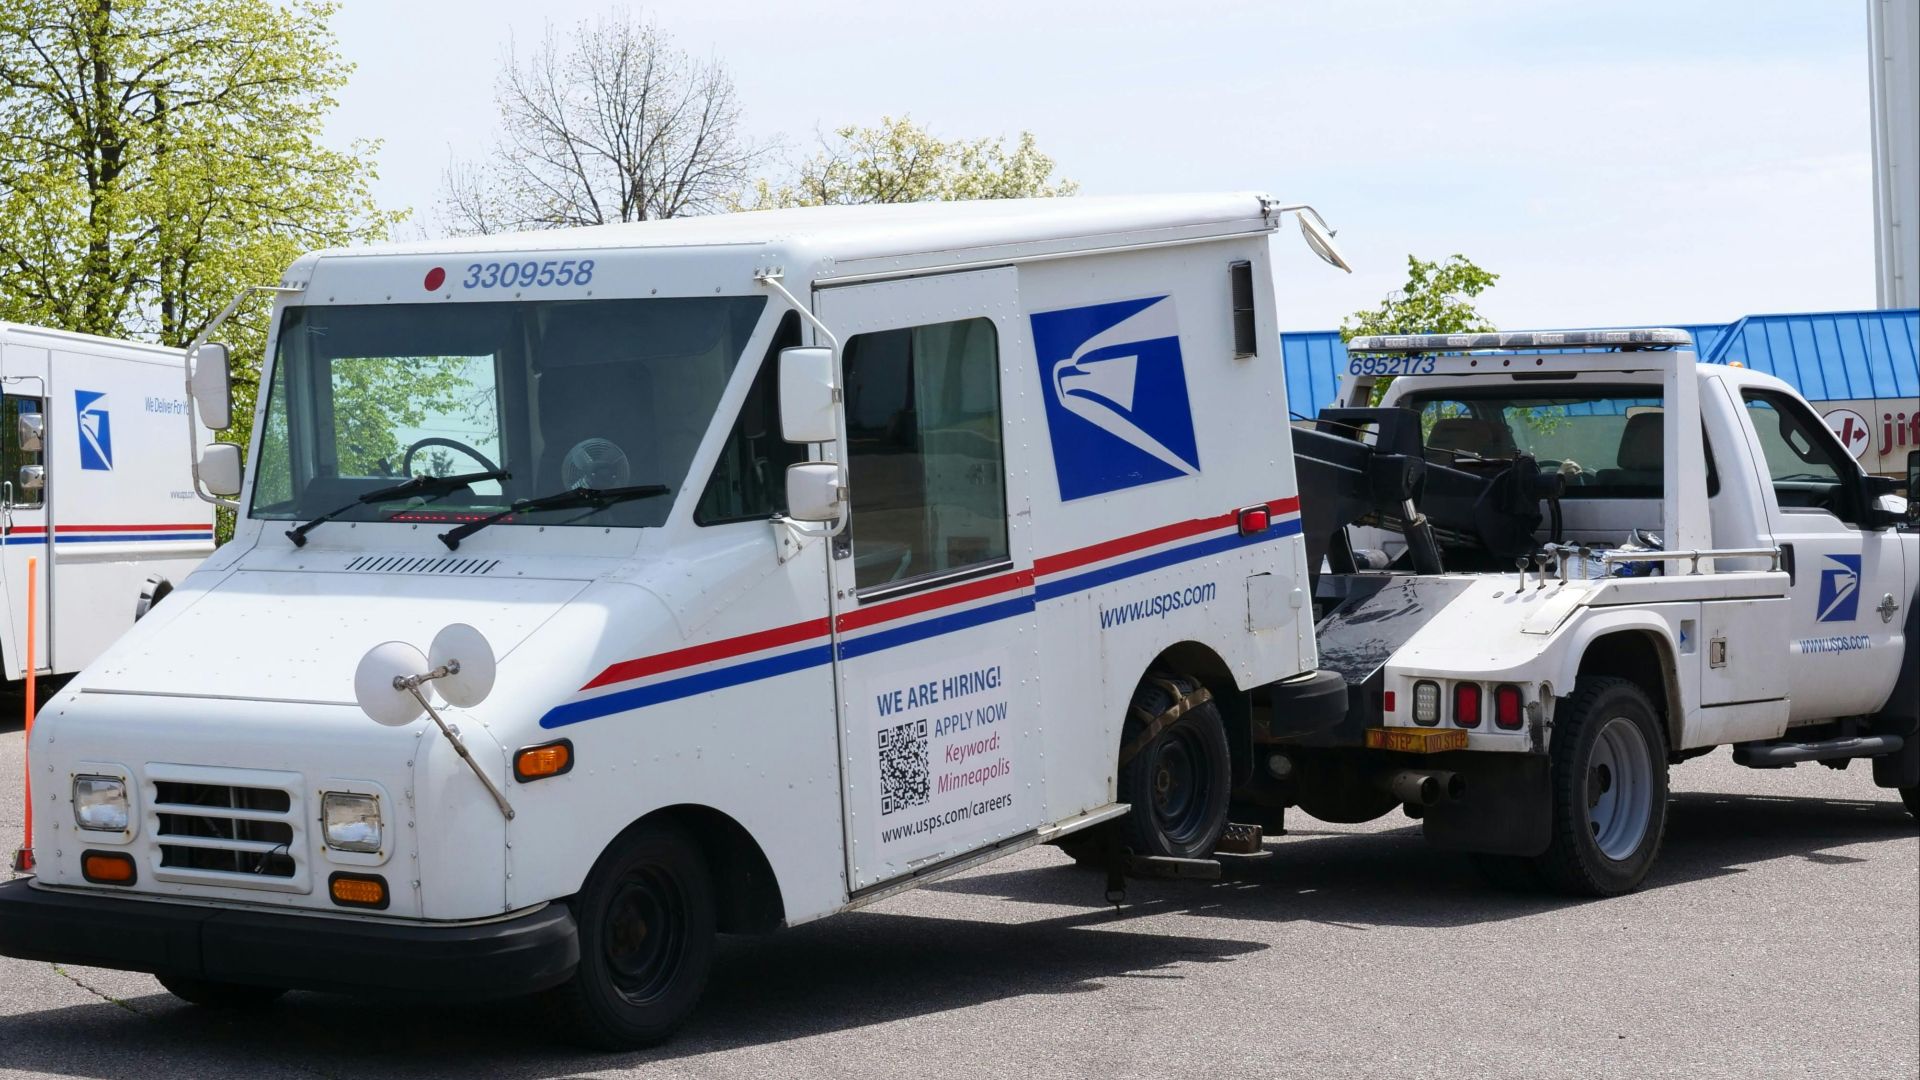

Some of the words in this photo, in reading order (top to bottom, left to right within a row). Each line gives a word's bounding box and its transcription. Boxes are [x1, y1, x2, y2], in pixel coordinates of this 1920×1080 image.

[463, 259, 594, 289] 3309558
[1349, 356, 1436, 376] 6952173
[145, 397, 154, 412] We
[154, 397, 173, 414] Deliver
[174, 399, 182, 415] For
[1100, 582, 1216, 630] www.usps.com
[1800, 634, 1871, 655] www.usps.com
[877, 690, 903, 717] WE
[907, 681, 939, 711] ARE
[942, 666, 1002, 701] HIRING!
[934, 710, 974, 738] APPLY
[976, 701, 1008, 727] NOW
[945, 731, 1000, 765] Keyword:
[1388, 734, 1412, 750] STEP
[937, 758, 1011, 795] Minneapolis
[881, 792, 1013, 844] www.usps.com/careers
